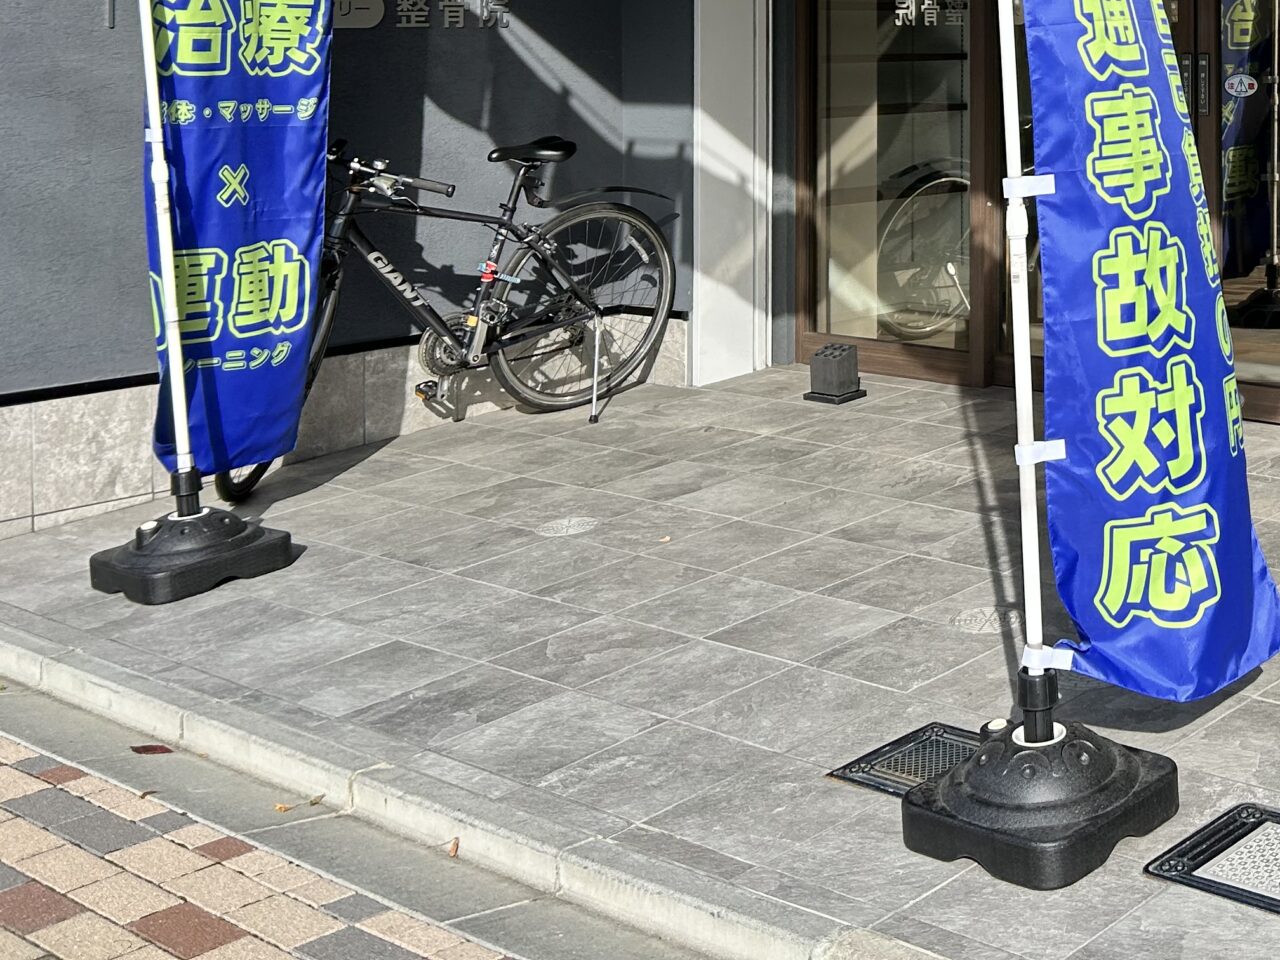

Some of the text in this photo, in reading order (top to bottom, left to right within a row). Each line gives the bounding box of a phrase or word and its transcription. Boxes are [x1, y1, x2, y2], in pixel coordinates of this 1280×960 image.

[162, 96, 318, 125] 体・マッサージ
[367, 251, 430, 308] GIANT
